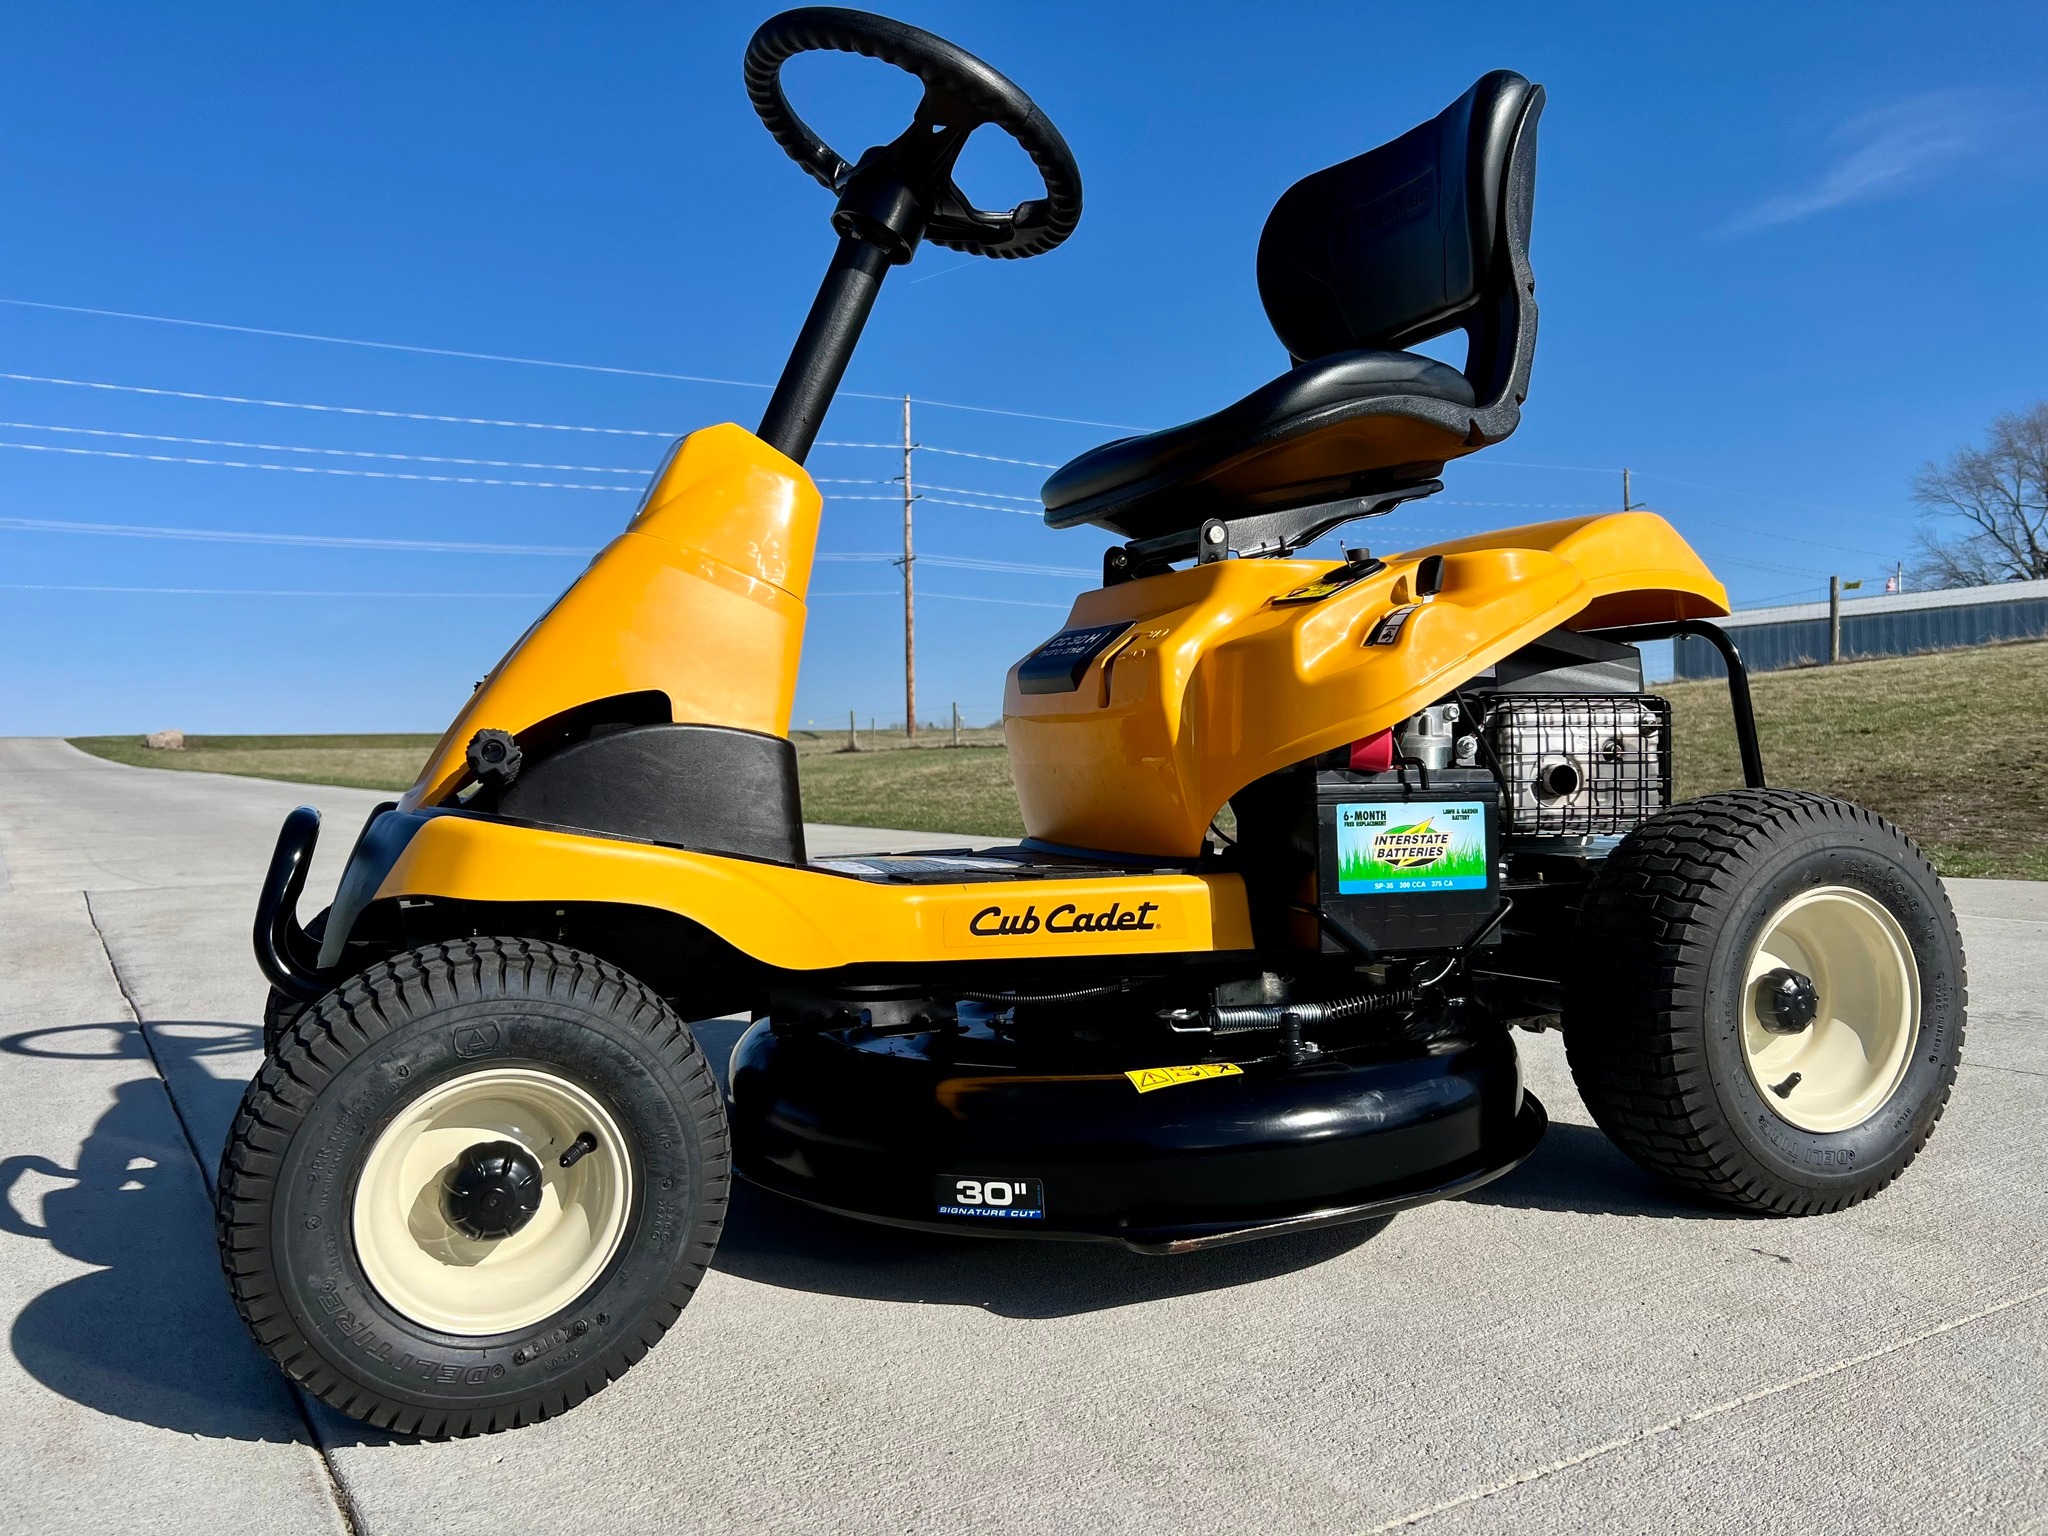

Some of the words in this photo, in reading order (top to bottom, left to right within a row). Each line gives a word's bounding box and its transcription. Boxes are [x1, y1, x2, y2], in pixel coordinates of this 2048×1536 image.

[1343, 810, 1387, 822] 6-MONTH
[1374, 833, 1449, 846] INTERSTATE
[1376, 846, 1444, 858] BATTERIES
[1374, 882, 1394, 890] SP-35
[1443, 879, 1454, 887] CA
[969, 905, 1041, 937] Cub
[1044, 902, 1160, 934] Cadet
[956, 1180, 1027, 1206] 30"
[939, 1206, 1007, 1217] SIGNATURE
